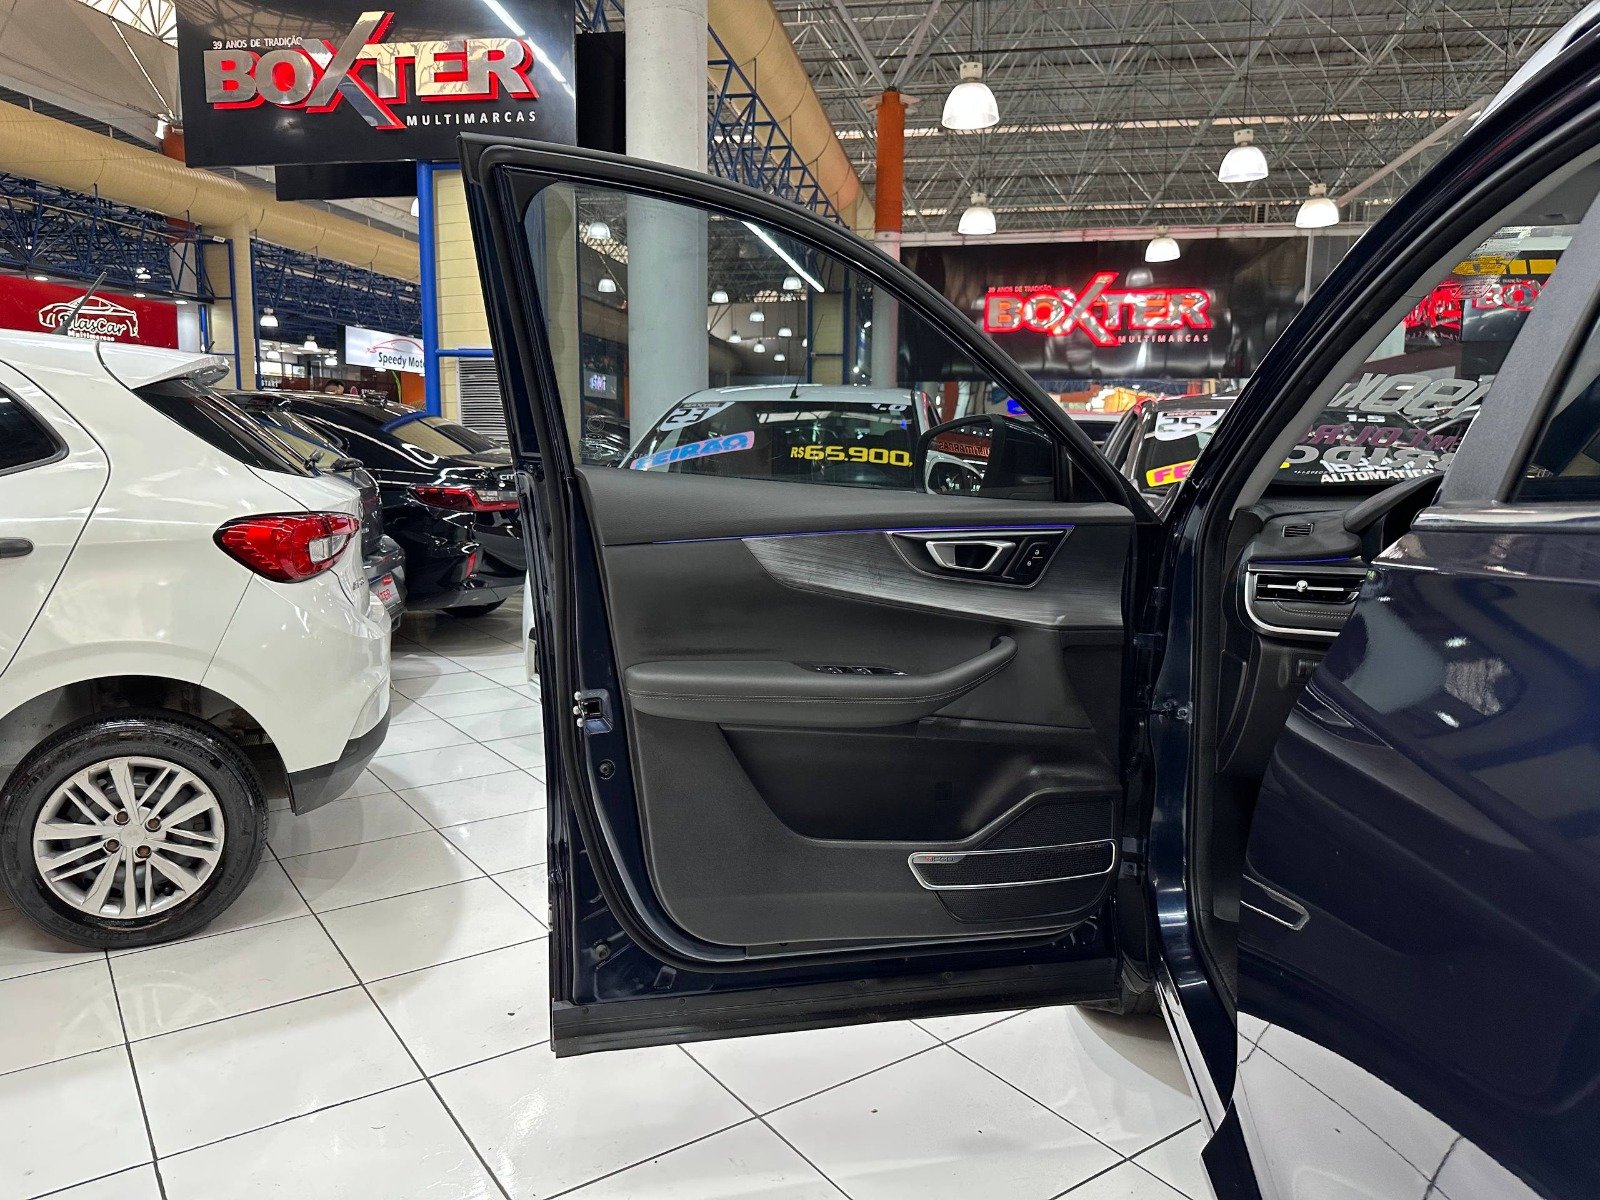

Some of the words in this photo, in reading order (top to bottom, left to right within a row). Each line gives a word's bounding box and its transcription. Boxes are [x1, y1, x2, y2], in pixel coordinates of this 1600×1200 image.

[212, 40, 223, 49] 39
[225, 39, 248, 49] ANOS
[250, 38, 261, 48] DE
[264, 35, 302, 48] TRADIÇÃO
[203, 11, 539, 130] BOXTER
[406, 111, 536, 126] MULTIMARCAS
[984, 271, 1213, 347] BOXTER
[1118, 333, 1209, 344] MULTIMARCAS
[378, 351, 407, 369] Speedy
[408, 356, 425, 368] Mot
[665, 408, 711, 424] 23
[1157, 416, 1202, 432] 25
